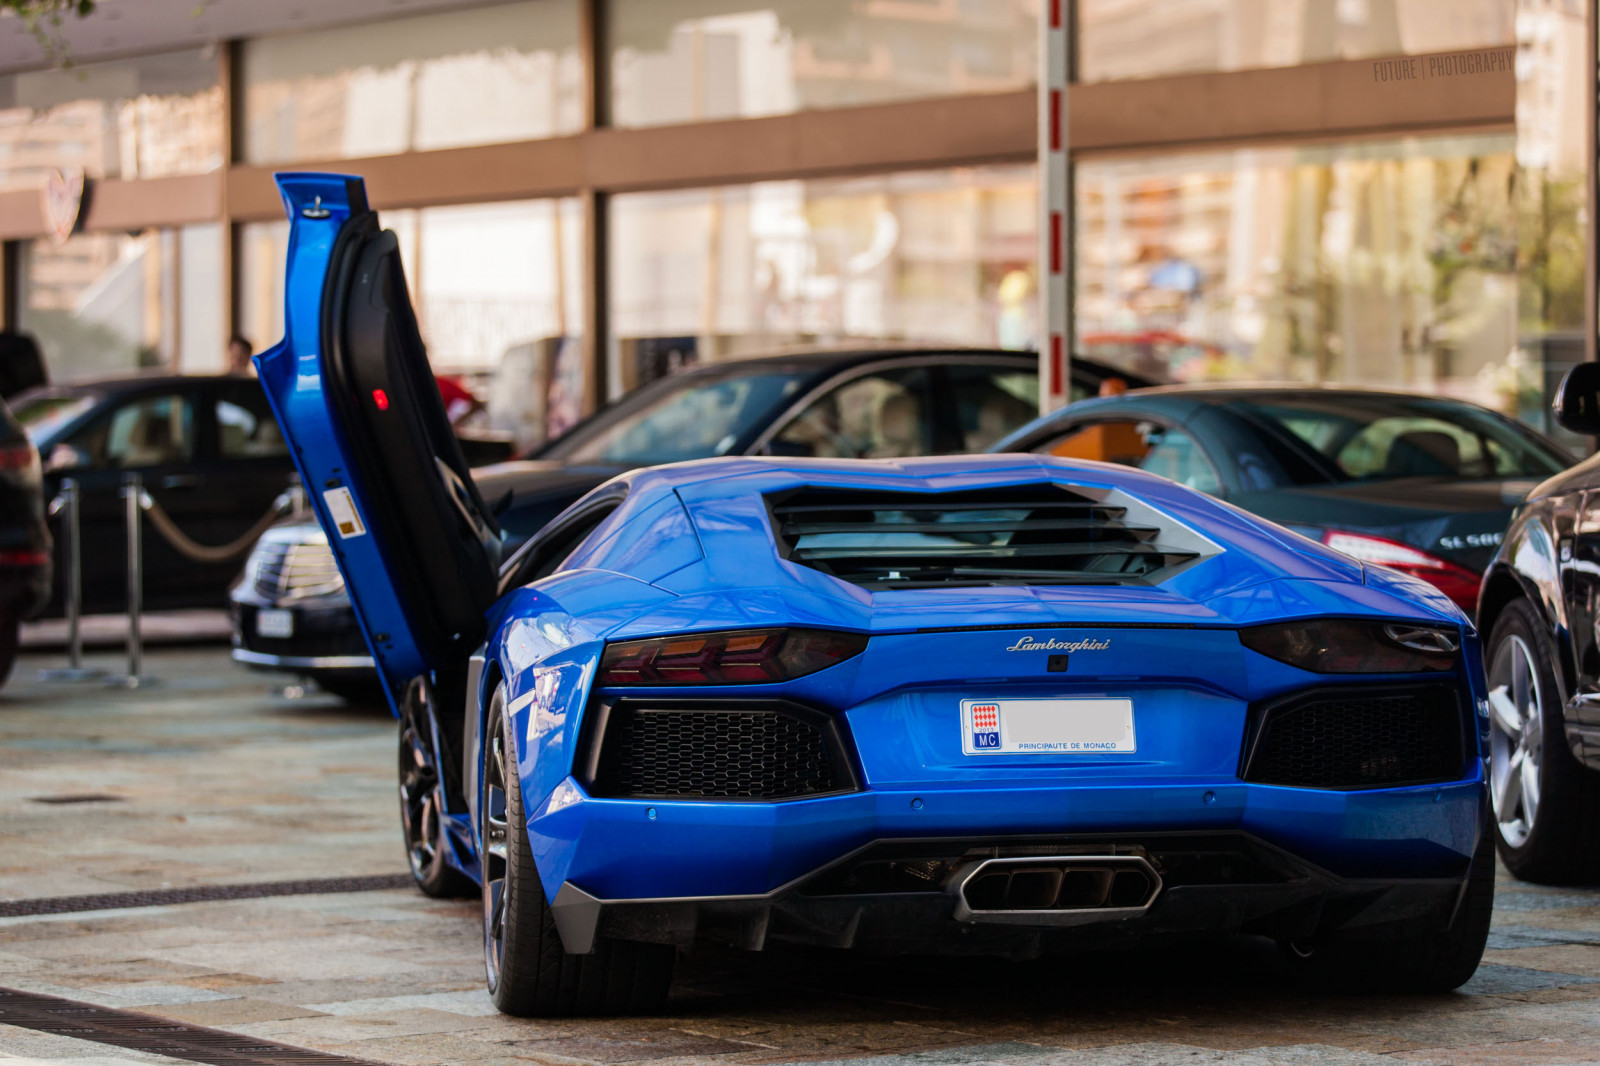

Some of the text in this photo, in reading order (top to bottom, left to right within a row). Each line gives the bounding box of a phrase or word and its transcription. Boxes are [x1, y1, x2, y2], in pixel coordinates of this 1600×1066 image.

[1006, 636, 1111, 653] Lamborghini
[979, 734, 996, 746] MC
[1018, 742, 1067, 750] PRINCIPAUTE
